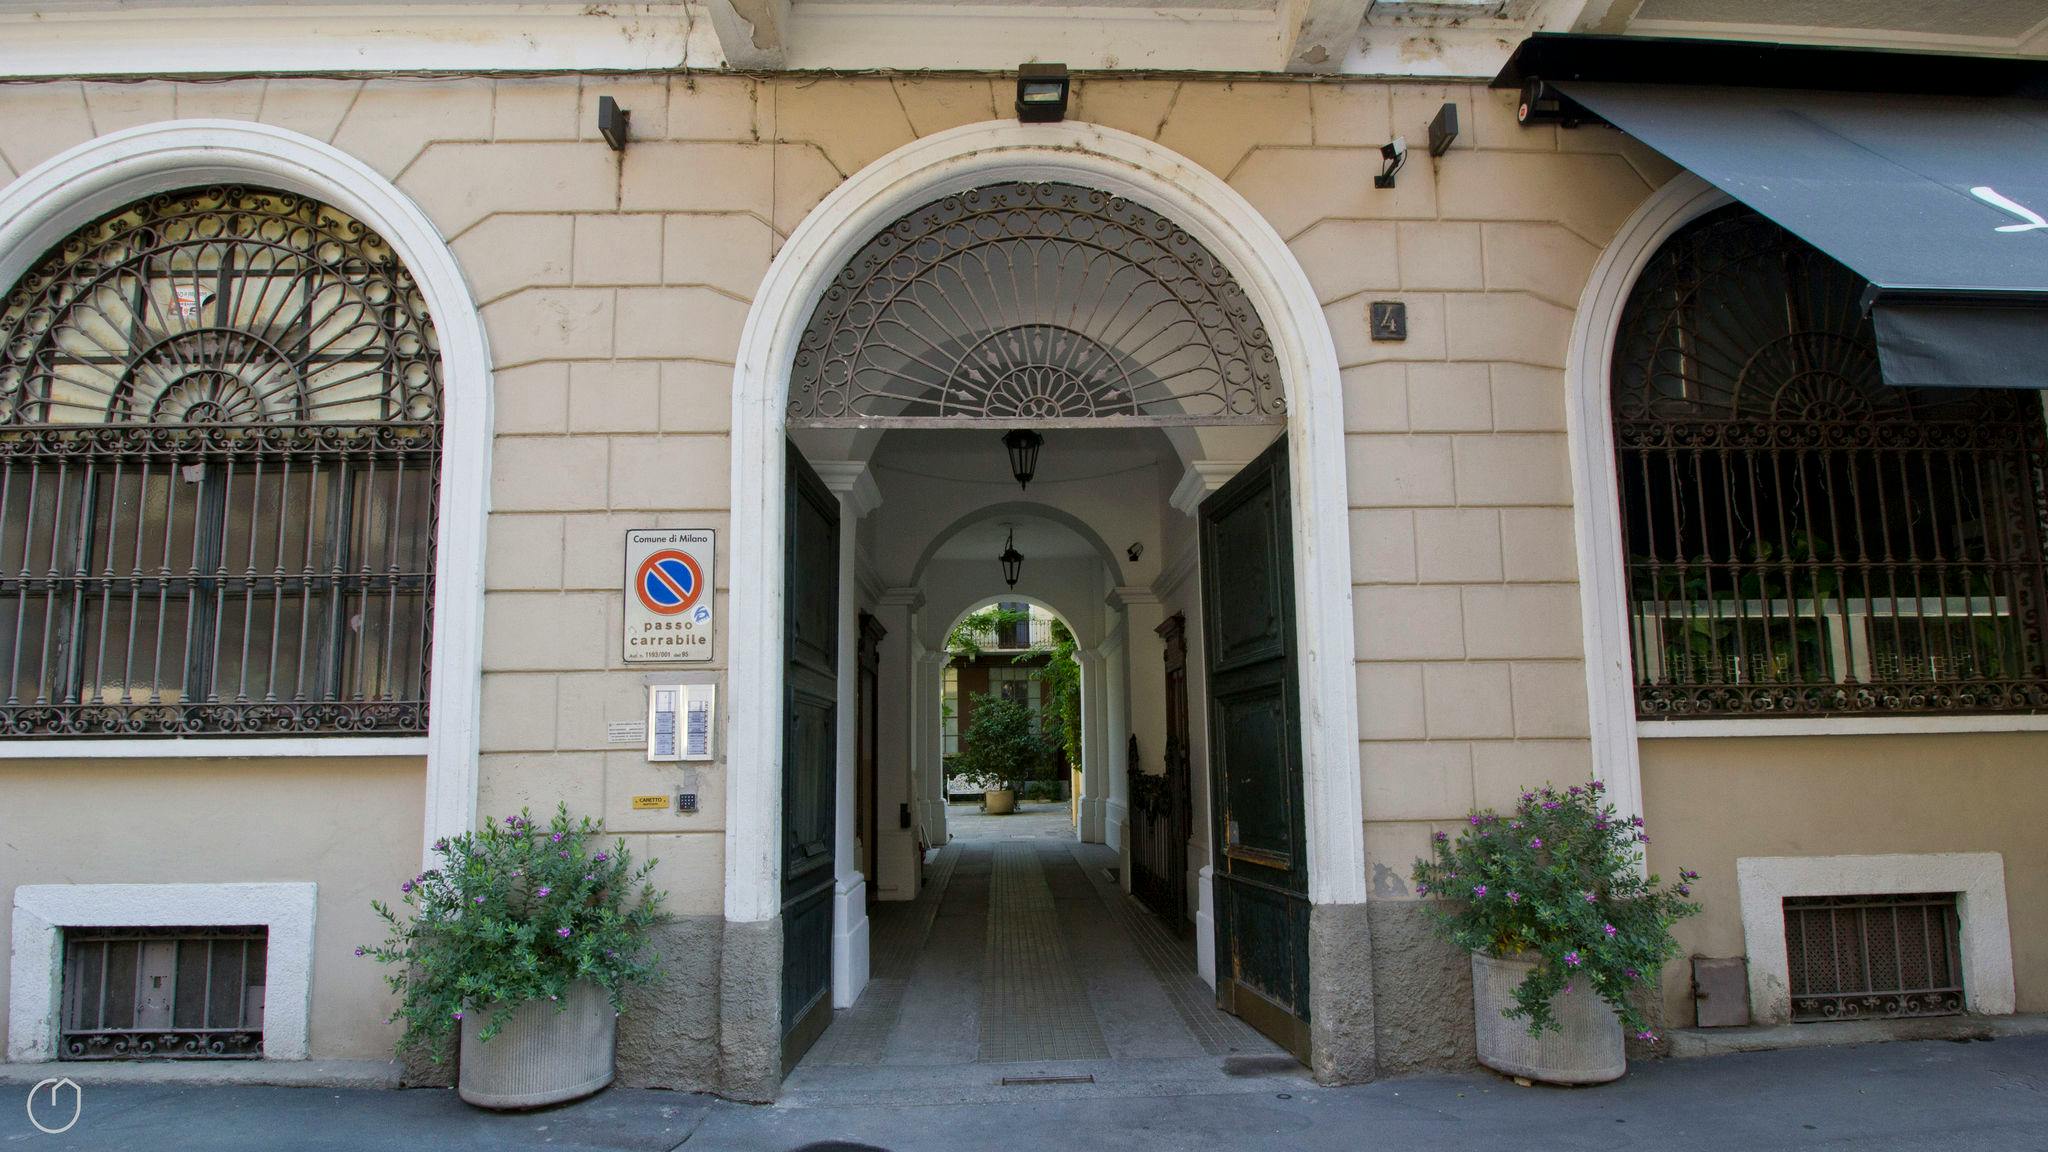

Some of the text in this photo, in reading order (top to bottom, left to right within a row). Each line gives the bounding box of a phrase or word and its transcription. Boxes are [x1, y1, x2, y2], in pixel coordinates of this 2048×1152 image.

[1380, 305, 1397, 332] 4
[633, 534, 708, 543] Comune di Milano
[644, 621, 693, 633] passo
[630, 634, 707, 646] carrabile
